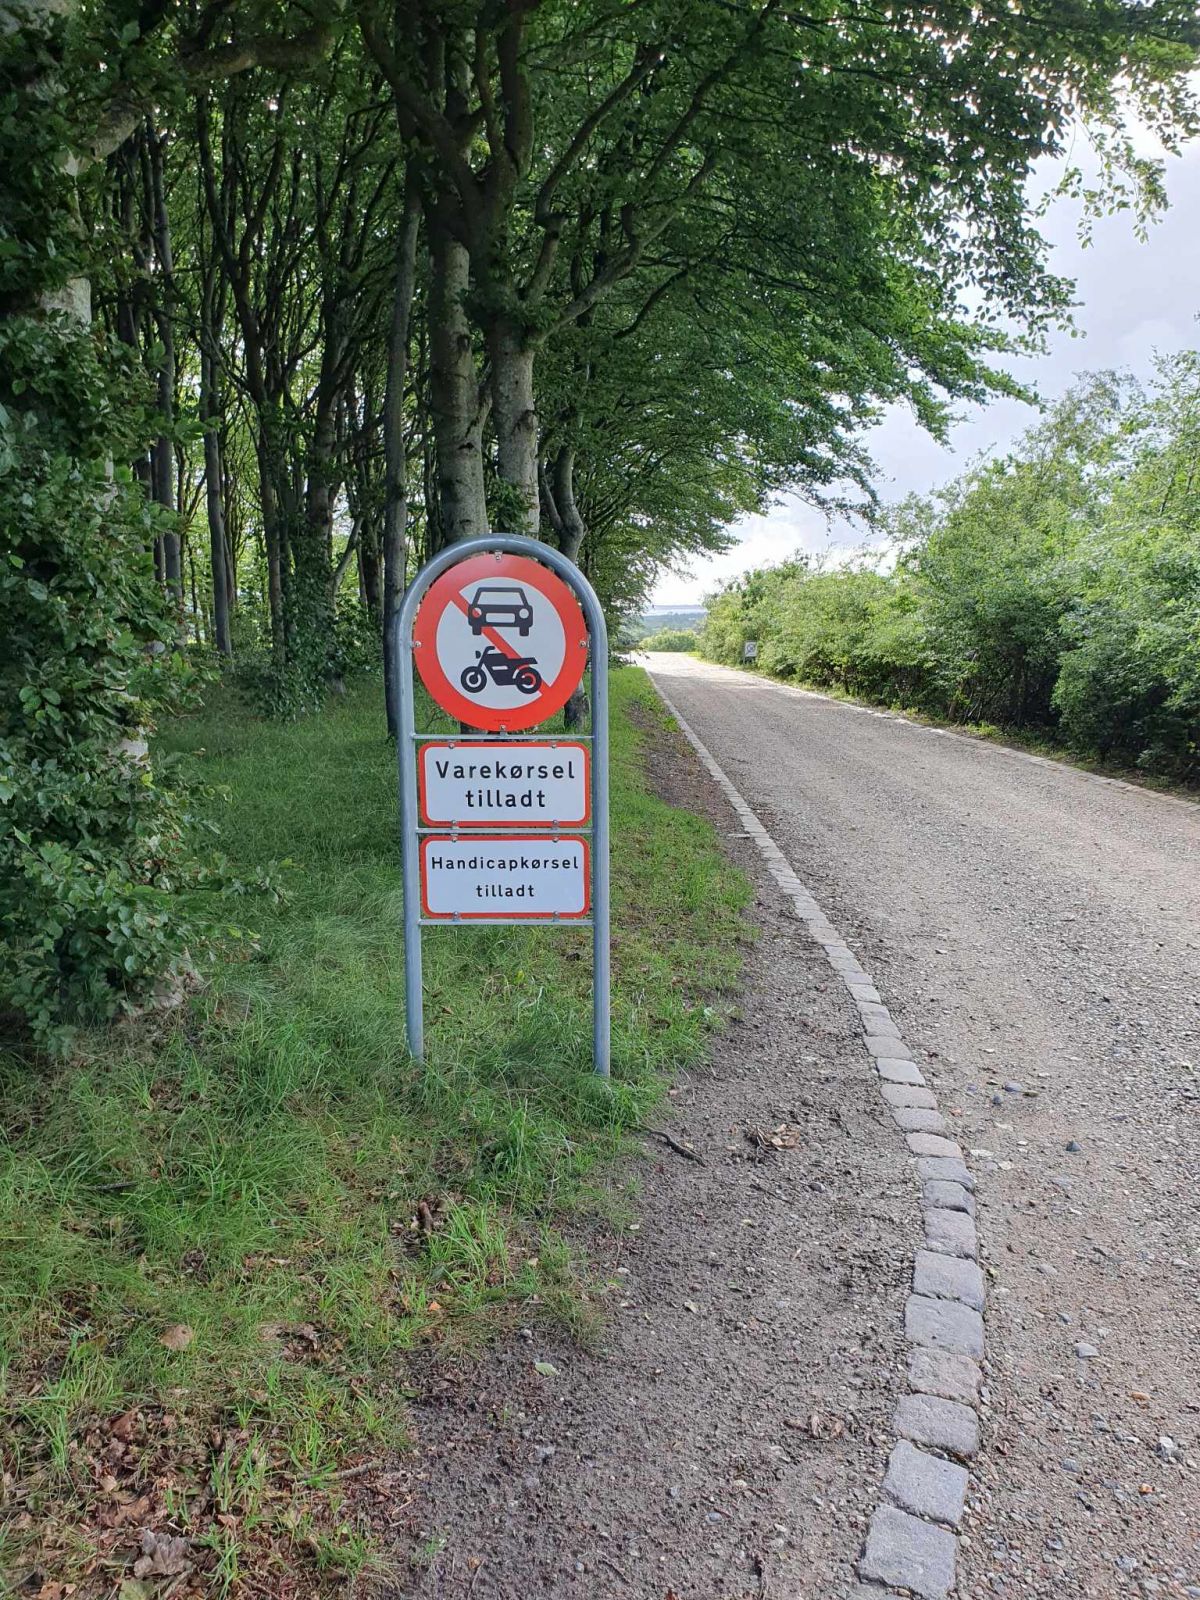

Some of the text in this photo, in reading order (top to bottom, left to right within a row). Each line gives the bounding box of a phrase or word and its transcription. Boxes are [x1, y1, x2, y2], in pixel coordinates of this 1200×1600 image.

[435, 760, 575, 780] Varekørsel
[465, 789, 546, 808] tilladt
[431, 856, 579, 871] Handicapkørsel
[475, 884, 535, 898] tilladt
